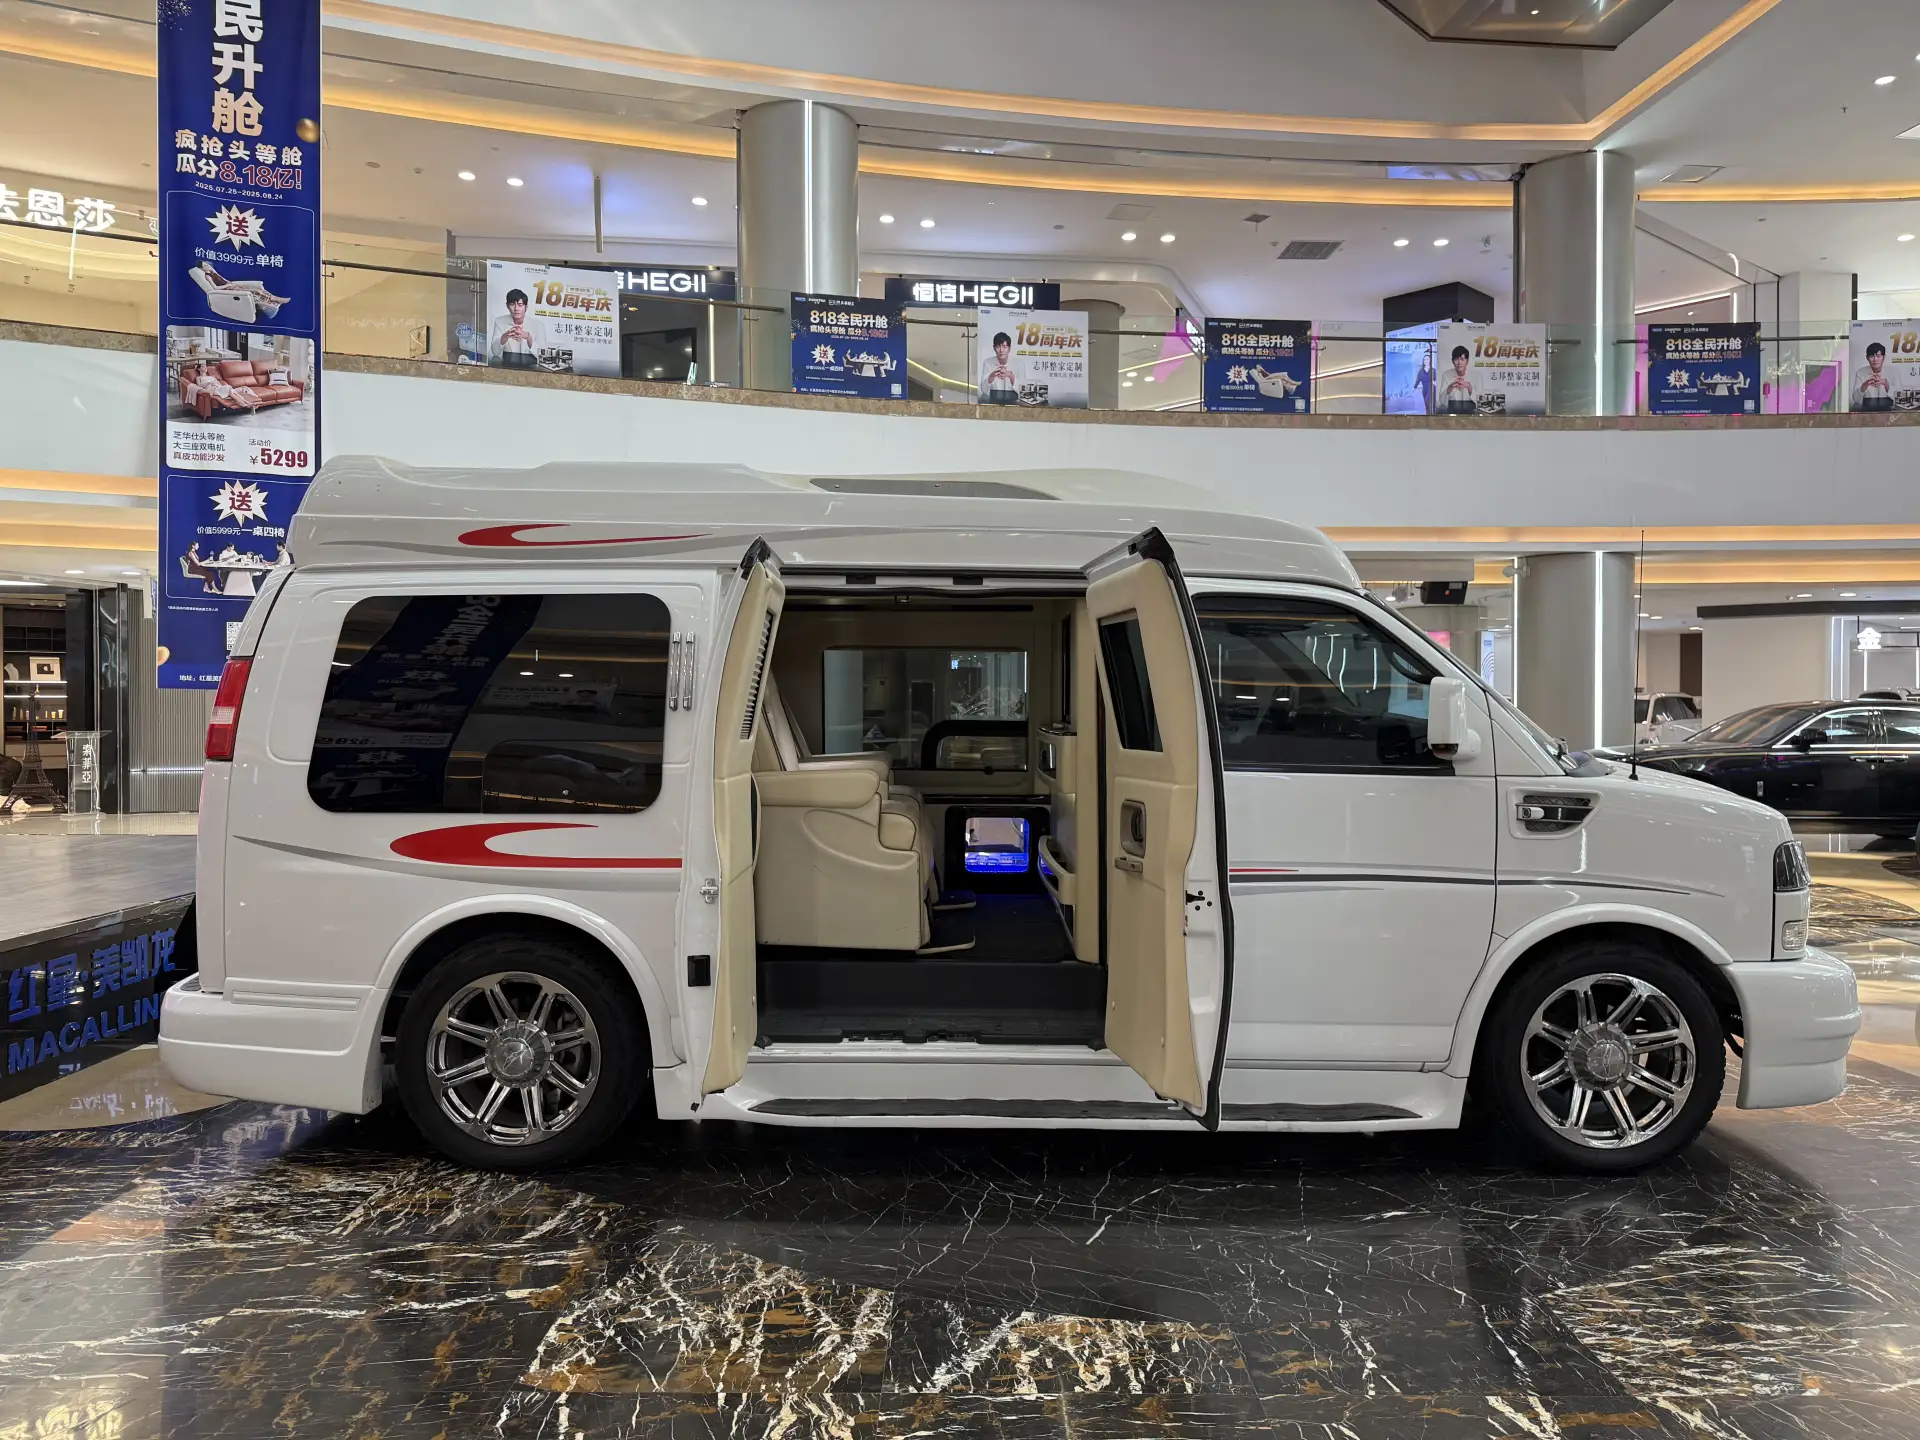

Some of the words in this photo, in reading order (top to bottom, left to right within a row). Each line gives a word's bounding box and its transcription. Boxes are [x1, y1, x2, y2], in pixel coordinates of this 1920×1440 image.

[175, 128, 303, 166] 疯抢头等舱
[195, 181, 283, 200] 2025.07.25-2025.08.24
[226, 213, 250, 238] 送
[533, 280, 614, 312] 18周年庆
[810, 310, 888, 329] 818全民升舱
[554, 323, 613, 338] 志邦整家定制
[1016, 322, 1084, 349] 18周年庆
[1221, 333, 1294, 348] 818全民升舱
[1473, 335, 1541, 360] 18周年庆
[1666, 337, 1742, 351] 818全民升舱
[1033, 361, 1083, 372] 志邦整家定制
[173, 431, 225, 442] 芝华仕头等舱
[248, 439, 272, 447] 活动价
[173, 441, 225, 452] 大三座双电机
[173, 452, 225, 462] 真皮功能沙发
[229, 491, 252, 512] 送
[8, 993, 162, 1075] MACALLIN
